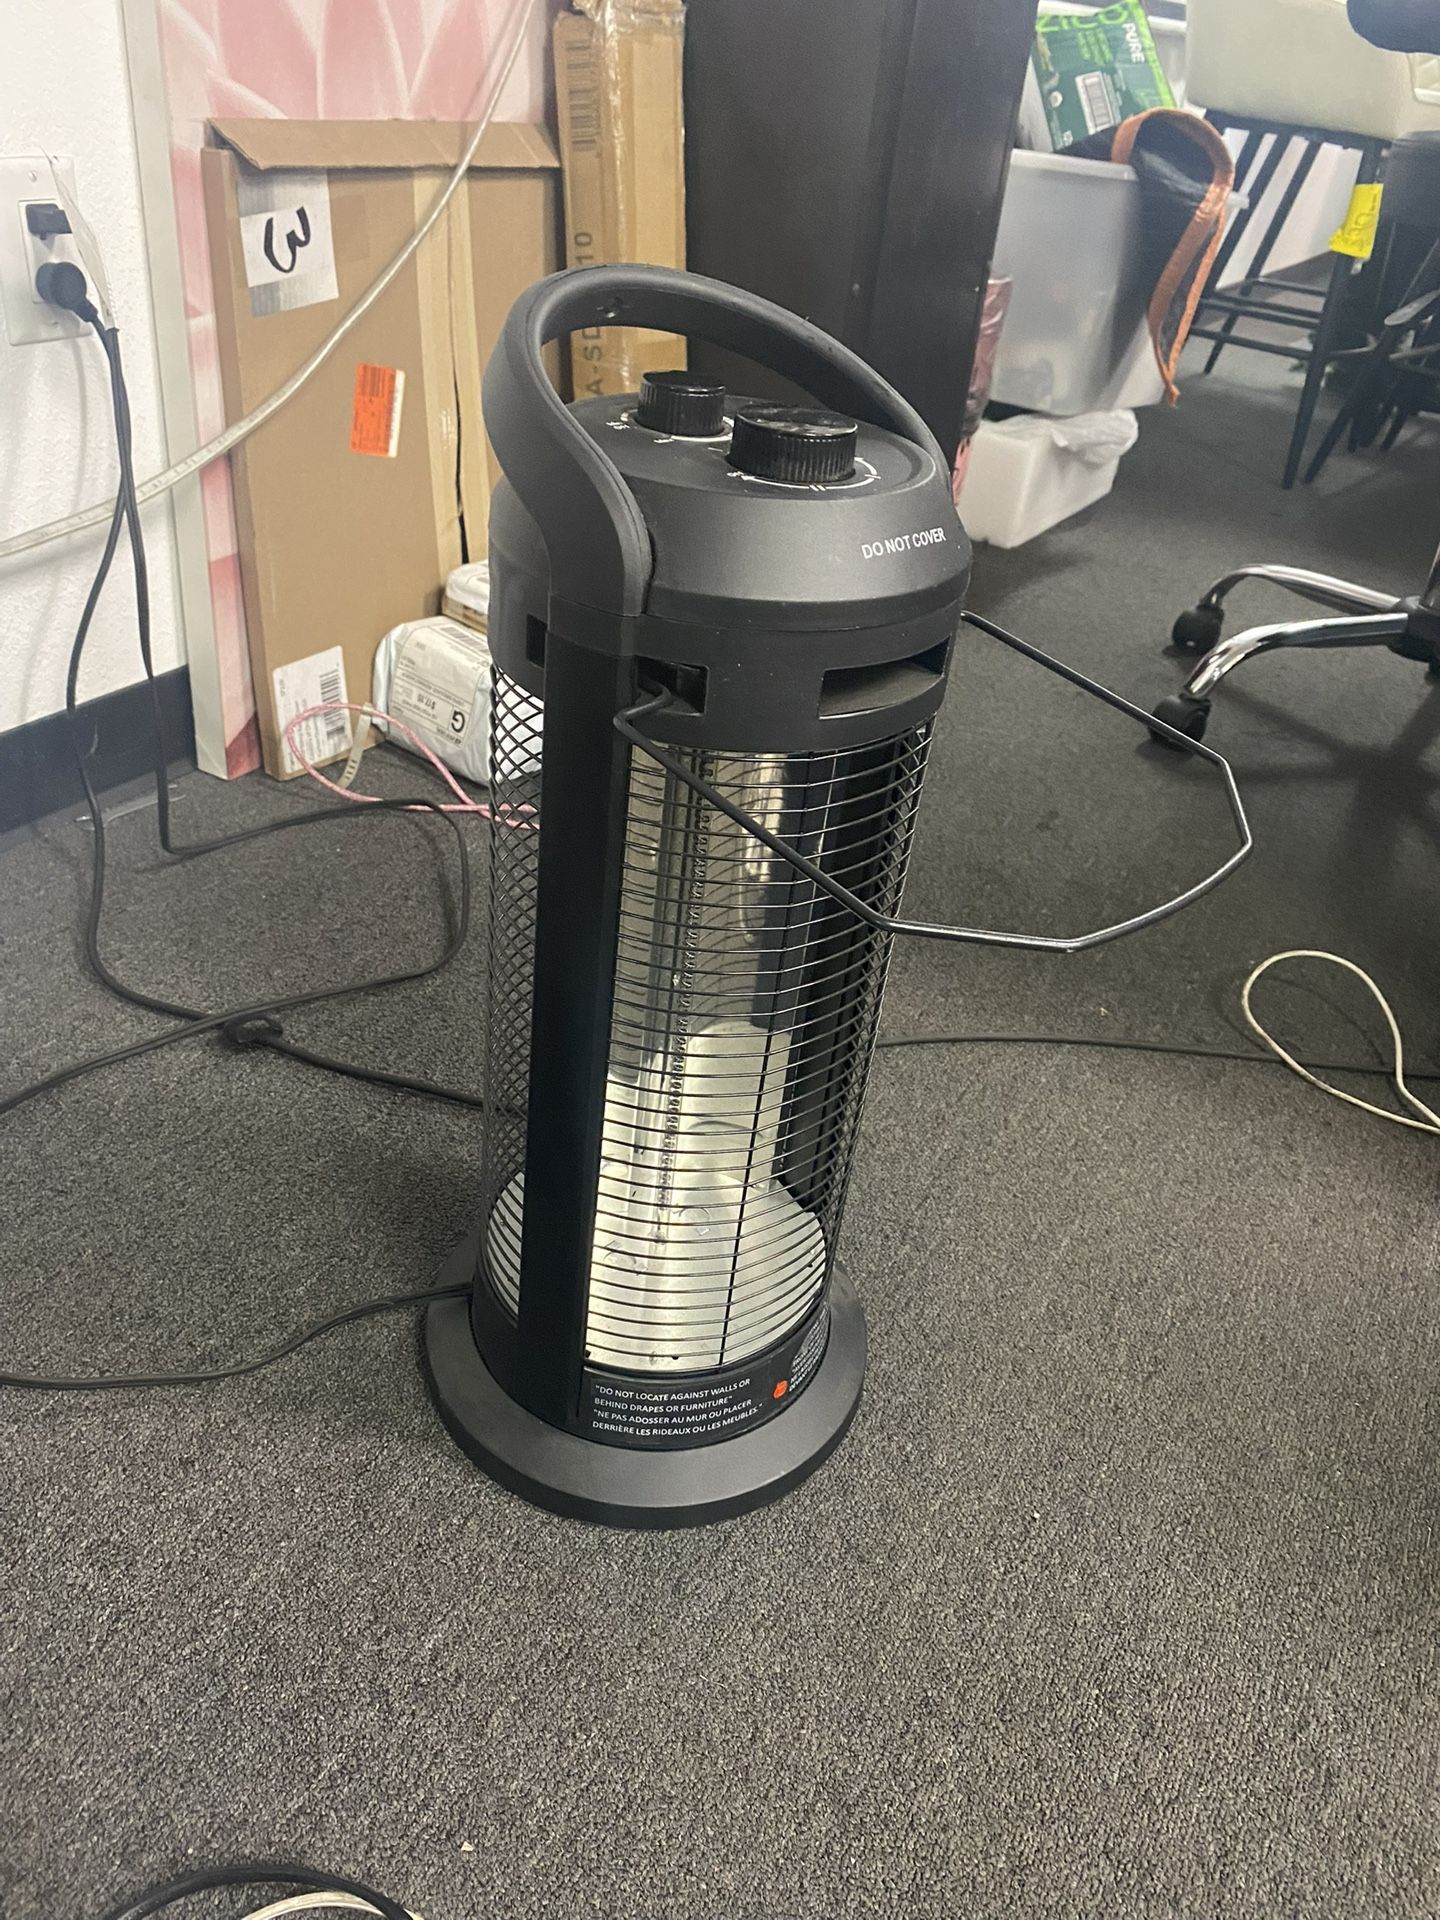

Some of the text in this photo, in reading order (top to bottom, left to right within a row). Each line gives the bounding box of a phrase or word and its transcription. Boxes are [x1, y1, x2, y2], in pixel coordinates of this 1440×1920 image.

[1121, 22, 1146, 64] PURE
[861, 527, 947, 559] DO NOT COVER
[451, 709, 466, 733] G
[615, 1389, 635, 1399] NOT
[635, 1392, 669, 1402] LOCATE
[670, 1389, 710, 1401] AGAINST
[710, 1382, 738, 1396] WALLS
[738, 1378, 751, 1388] OR
[594, 1397, 628, 1410] BEHIND
[629, 1404, 665, 1413] DRAPES
[665, 1405, 679, 1413] OR
[611, 1412, 628, 1422] PAS
[628, 1415, 670, 1425] ADOSSER
[671, 1416, 685, 1424] AU
[686, 1413, 708, 1423] MUR
[708, 1410, 722, 1419] OU
[723, 1399, 752, 1415] PLACER
[592, 1420, 635, 1434] DERRIÈRE
[635, 1428, 651, 1436] LES
[652, 1427, 691, 1436] RIDEAUX
[692, 1424, 706, 1434] OU
[707, 1420, 722, 1431] LES
